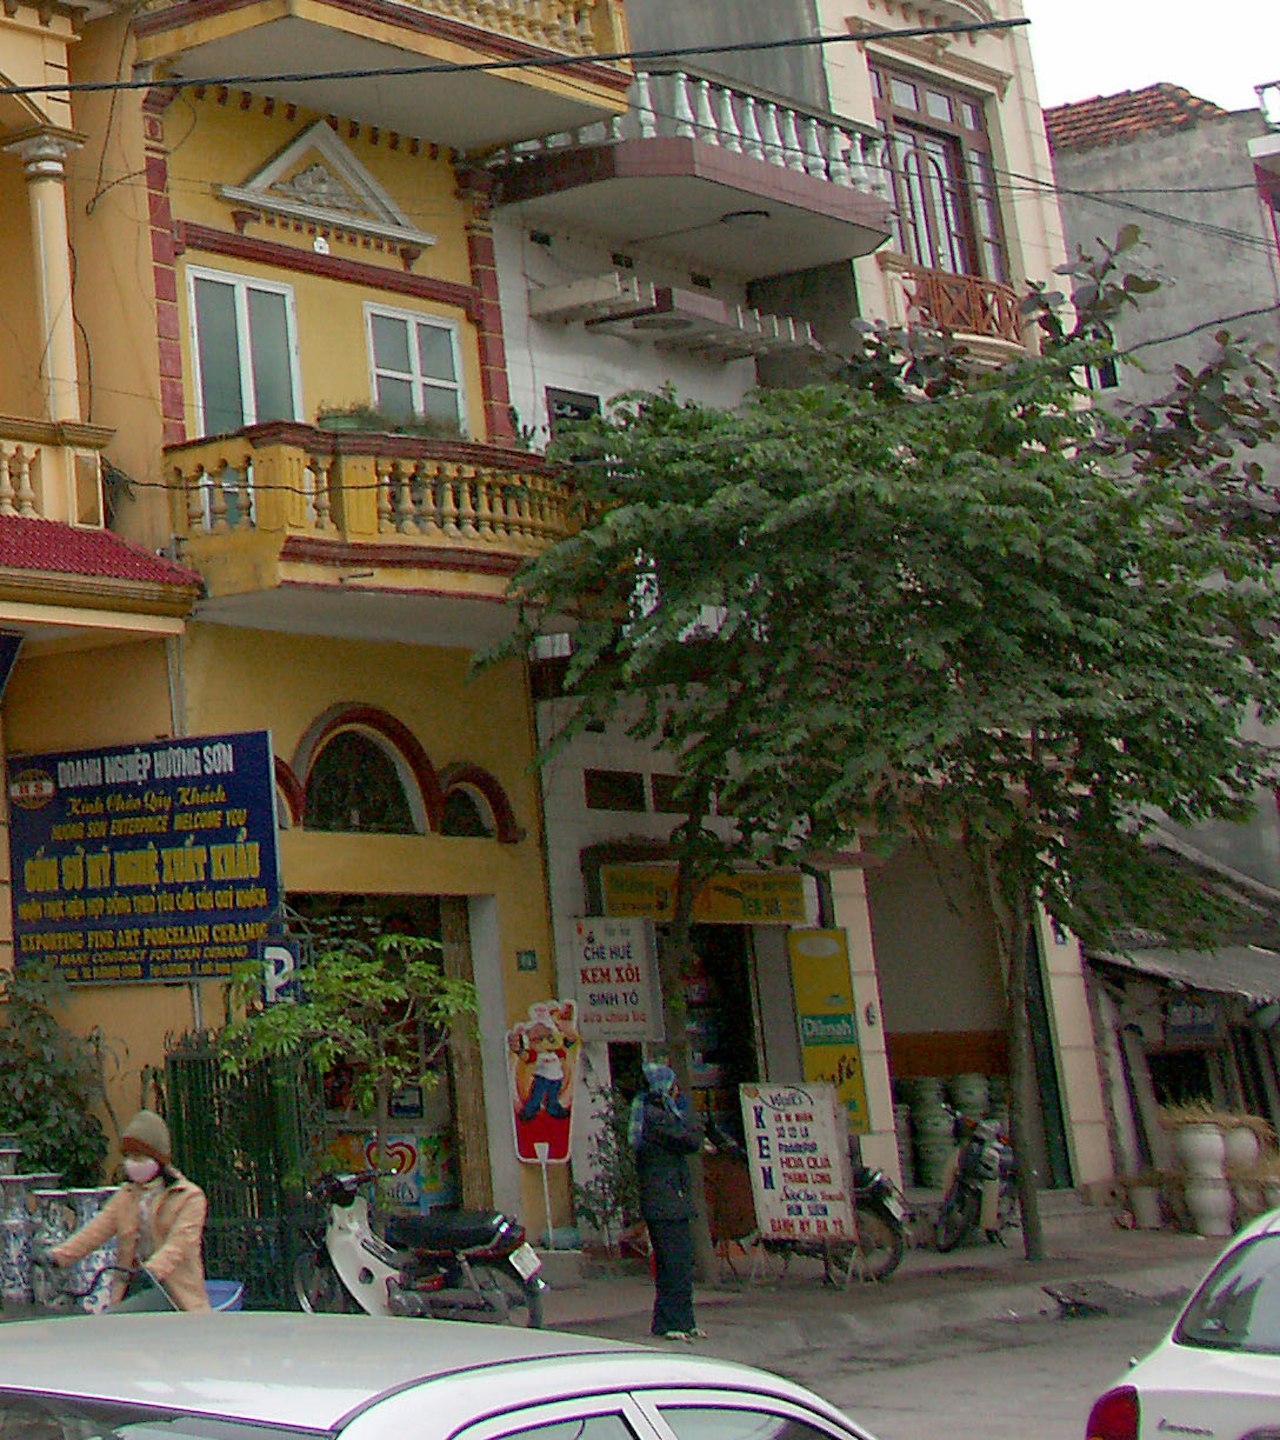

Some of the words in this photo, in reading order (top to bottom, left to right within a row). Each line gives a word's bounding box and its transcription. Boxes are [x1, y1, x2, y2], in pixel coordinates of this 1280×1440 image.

[226, 808, 247, 828] YOU
[581, 967, 611, 984] KEM
[590, 993, 618, 1006] SINH
